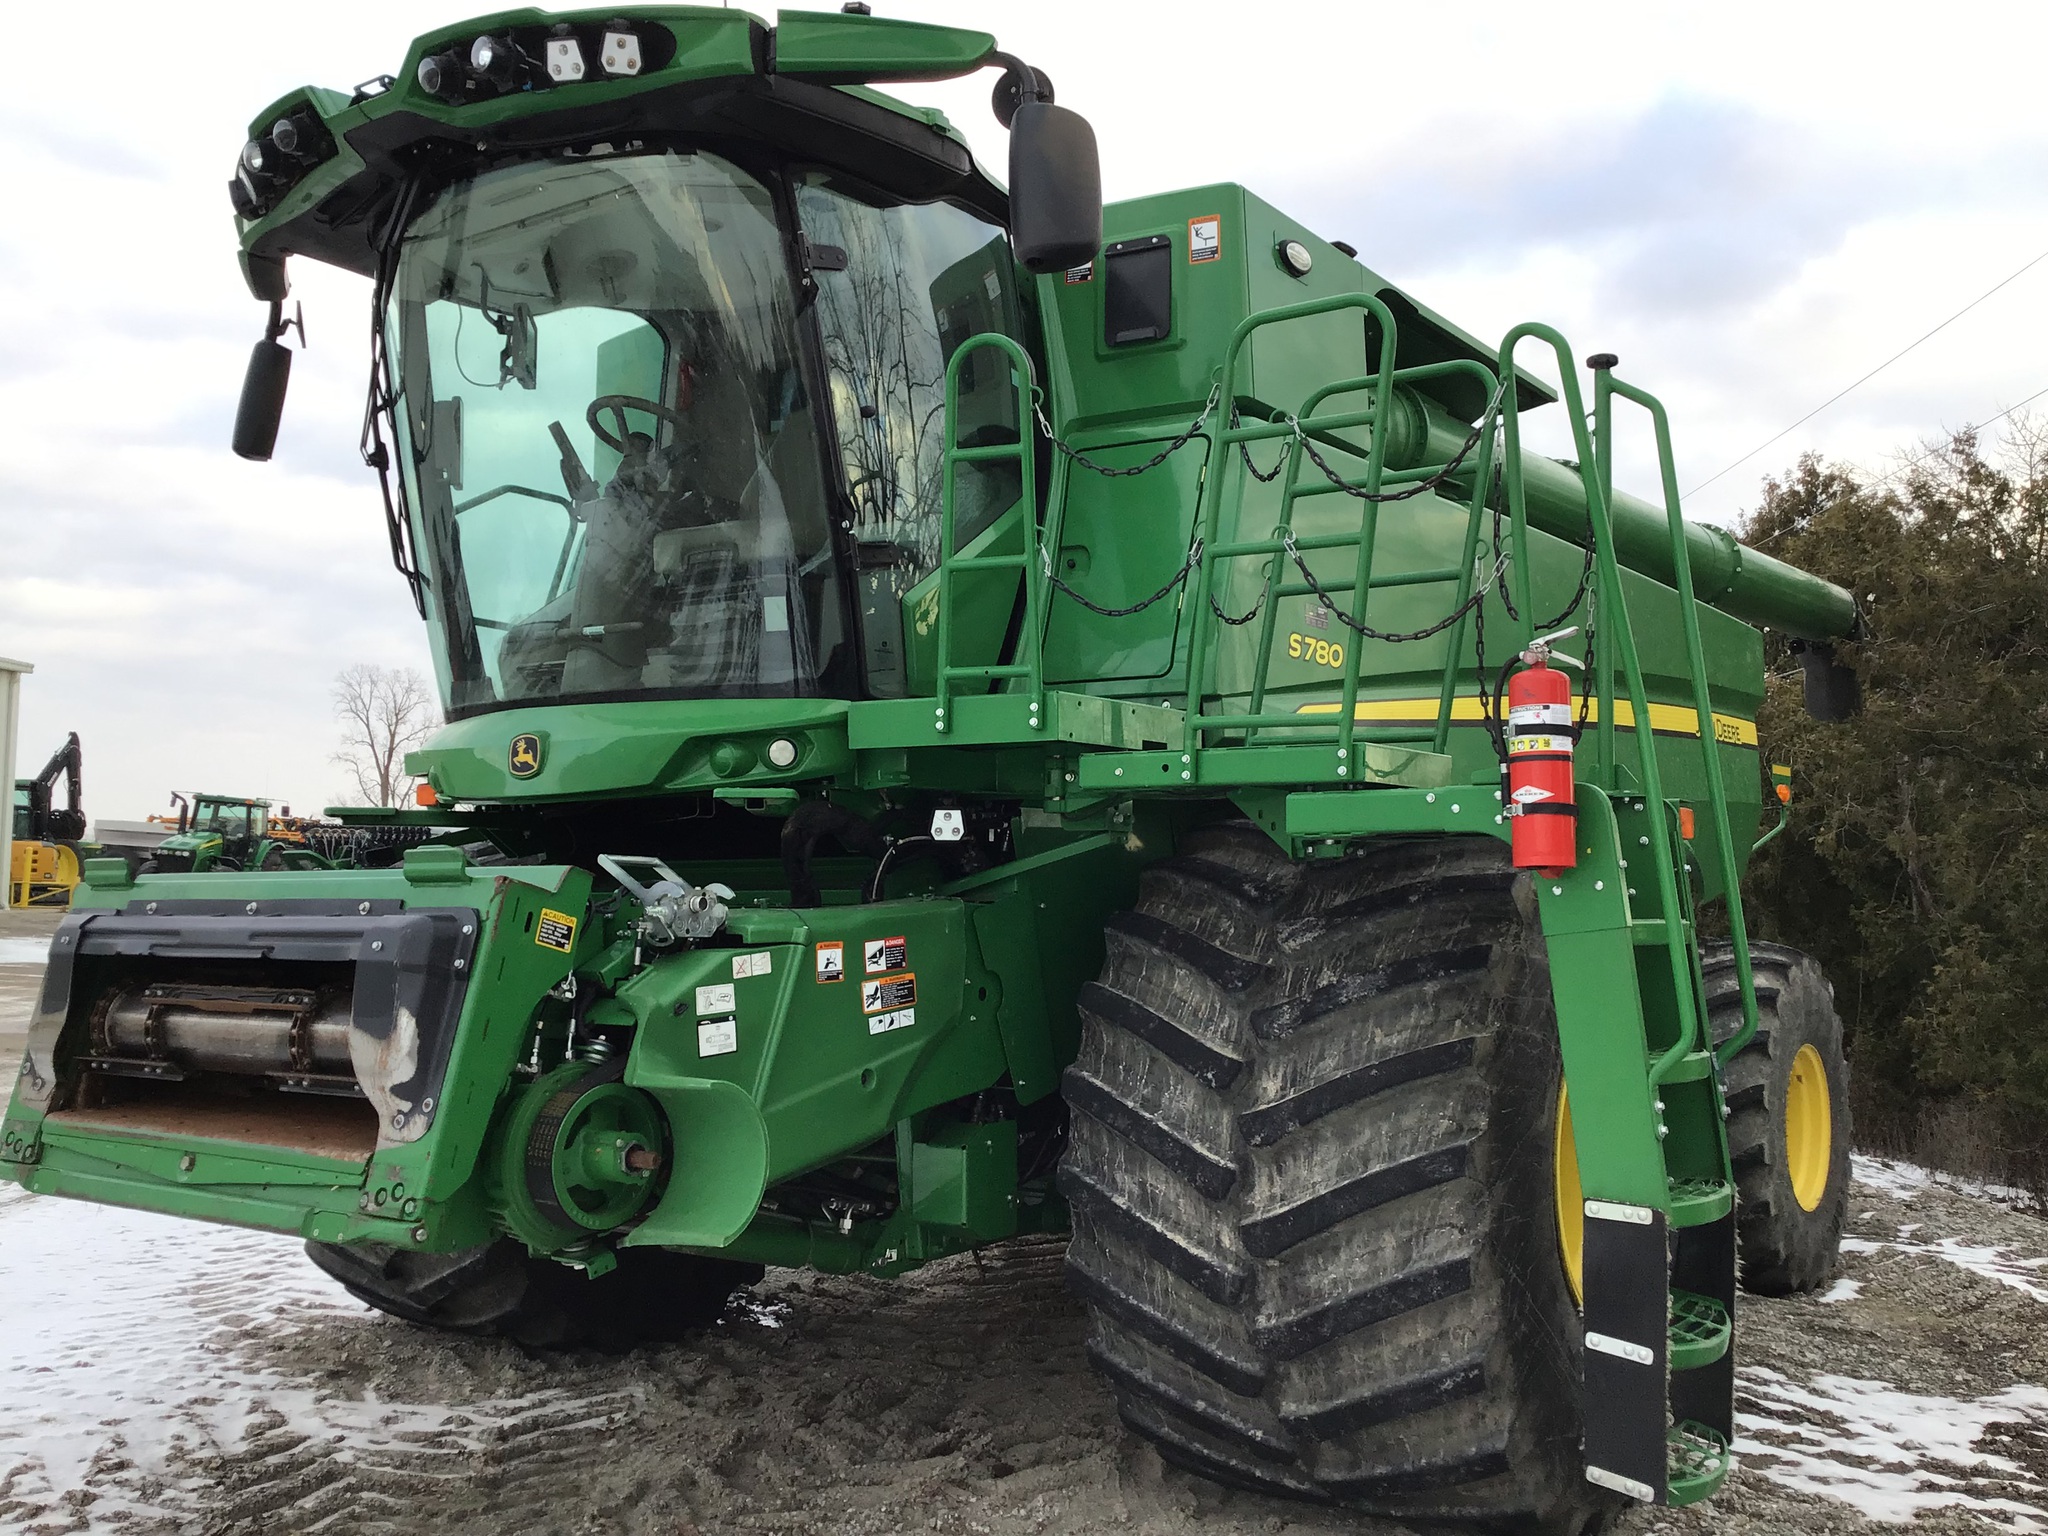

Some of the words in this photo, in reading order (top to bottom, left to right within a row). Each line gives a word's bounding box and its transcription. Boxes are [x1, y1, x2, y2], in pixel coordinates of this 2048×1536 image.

[1288, 631, 1344, 669] S780
[1715, 718, 1742, 745] DEERE
[547, 911, 575, 925] CAUTION
